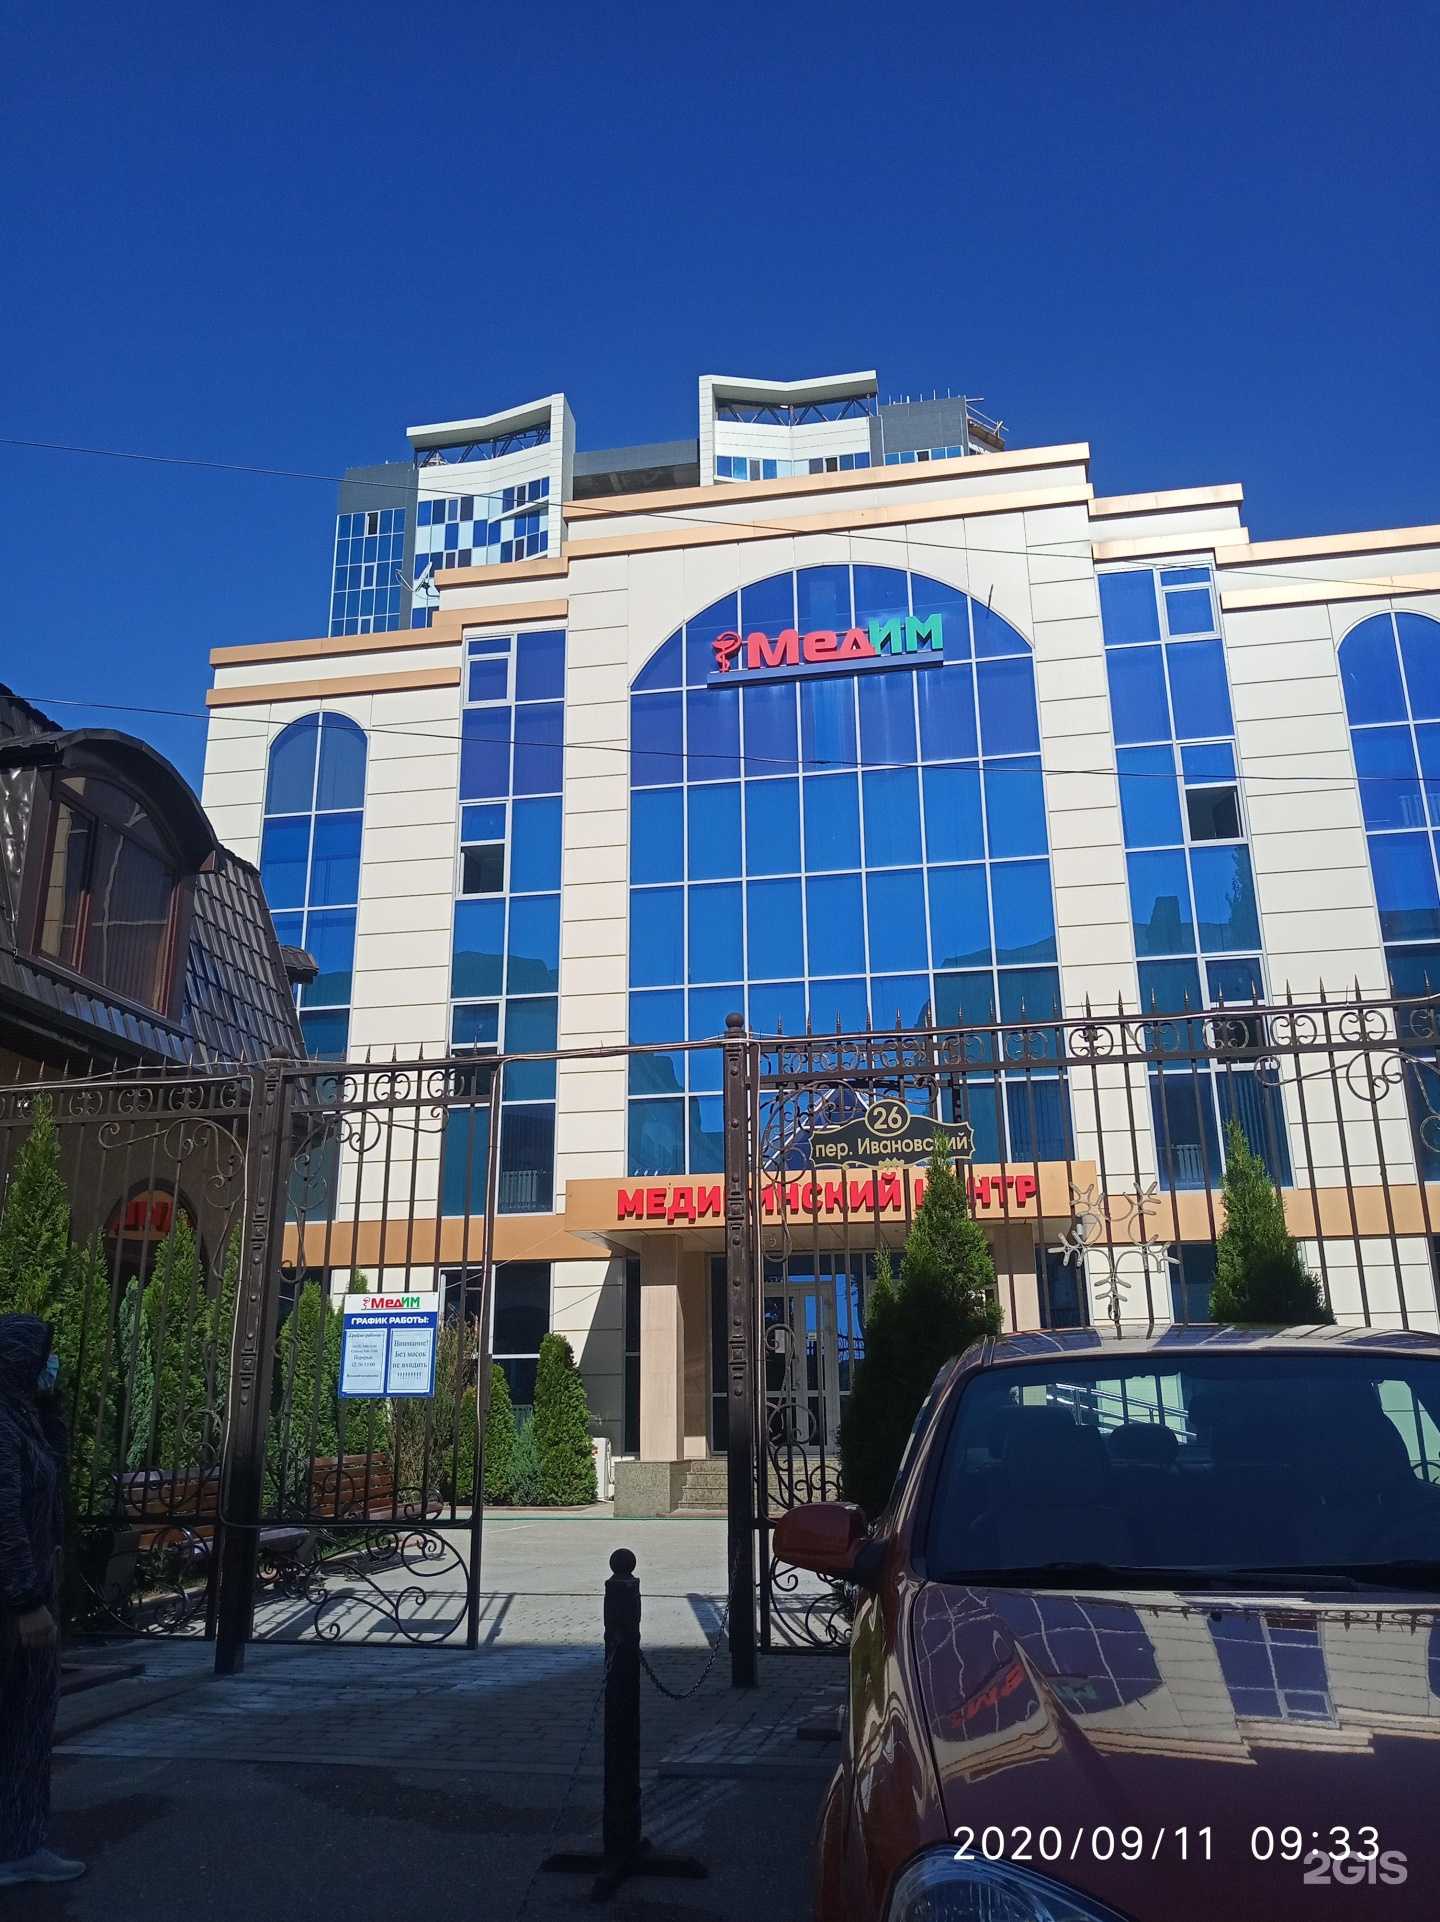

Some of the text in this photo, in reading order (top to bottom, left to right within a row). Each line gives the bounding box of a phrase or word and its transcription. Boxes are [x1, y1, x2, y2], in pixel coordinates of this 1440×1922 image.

[747, 613, 943, 670] МедИМ
[873, 1106, 902, 1130] 26
[815, 1131, 969, 1160] пер. Ивановсий
[617, 1170, 1038, 1226] МЕДИИНСКИЙ НТР
[370, 1296, 421, 1309] МедИМ
[351, 1315, 430, 1325] ГРАФИК РАБОТЫ:
